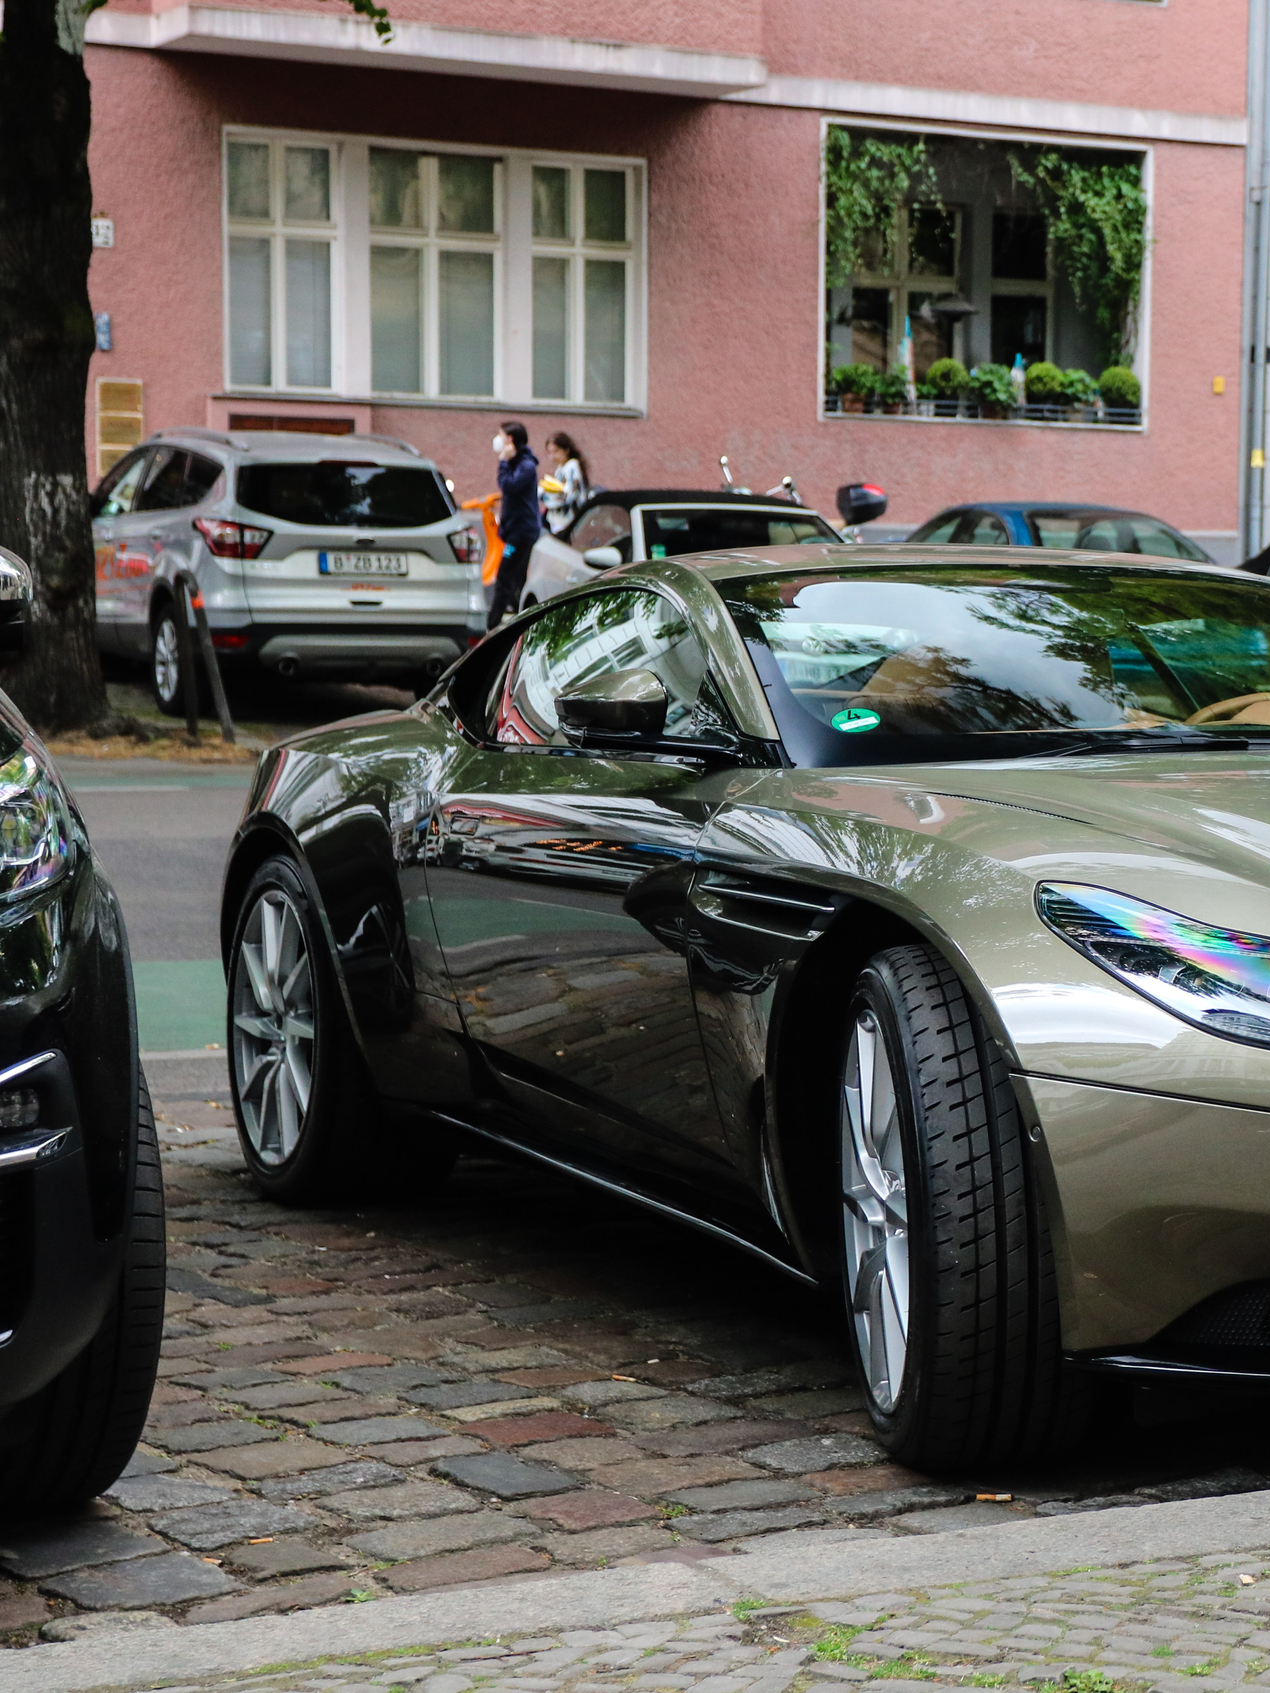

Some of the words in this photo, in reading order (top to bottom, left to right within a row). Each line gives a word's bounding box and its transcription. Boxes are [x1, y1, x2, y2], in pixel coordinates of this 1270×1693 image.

[334, 554, 343, 571] B
[376, 554, 401, 572] 123
[847, 709, 861, 720] 4
